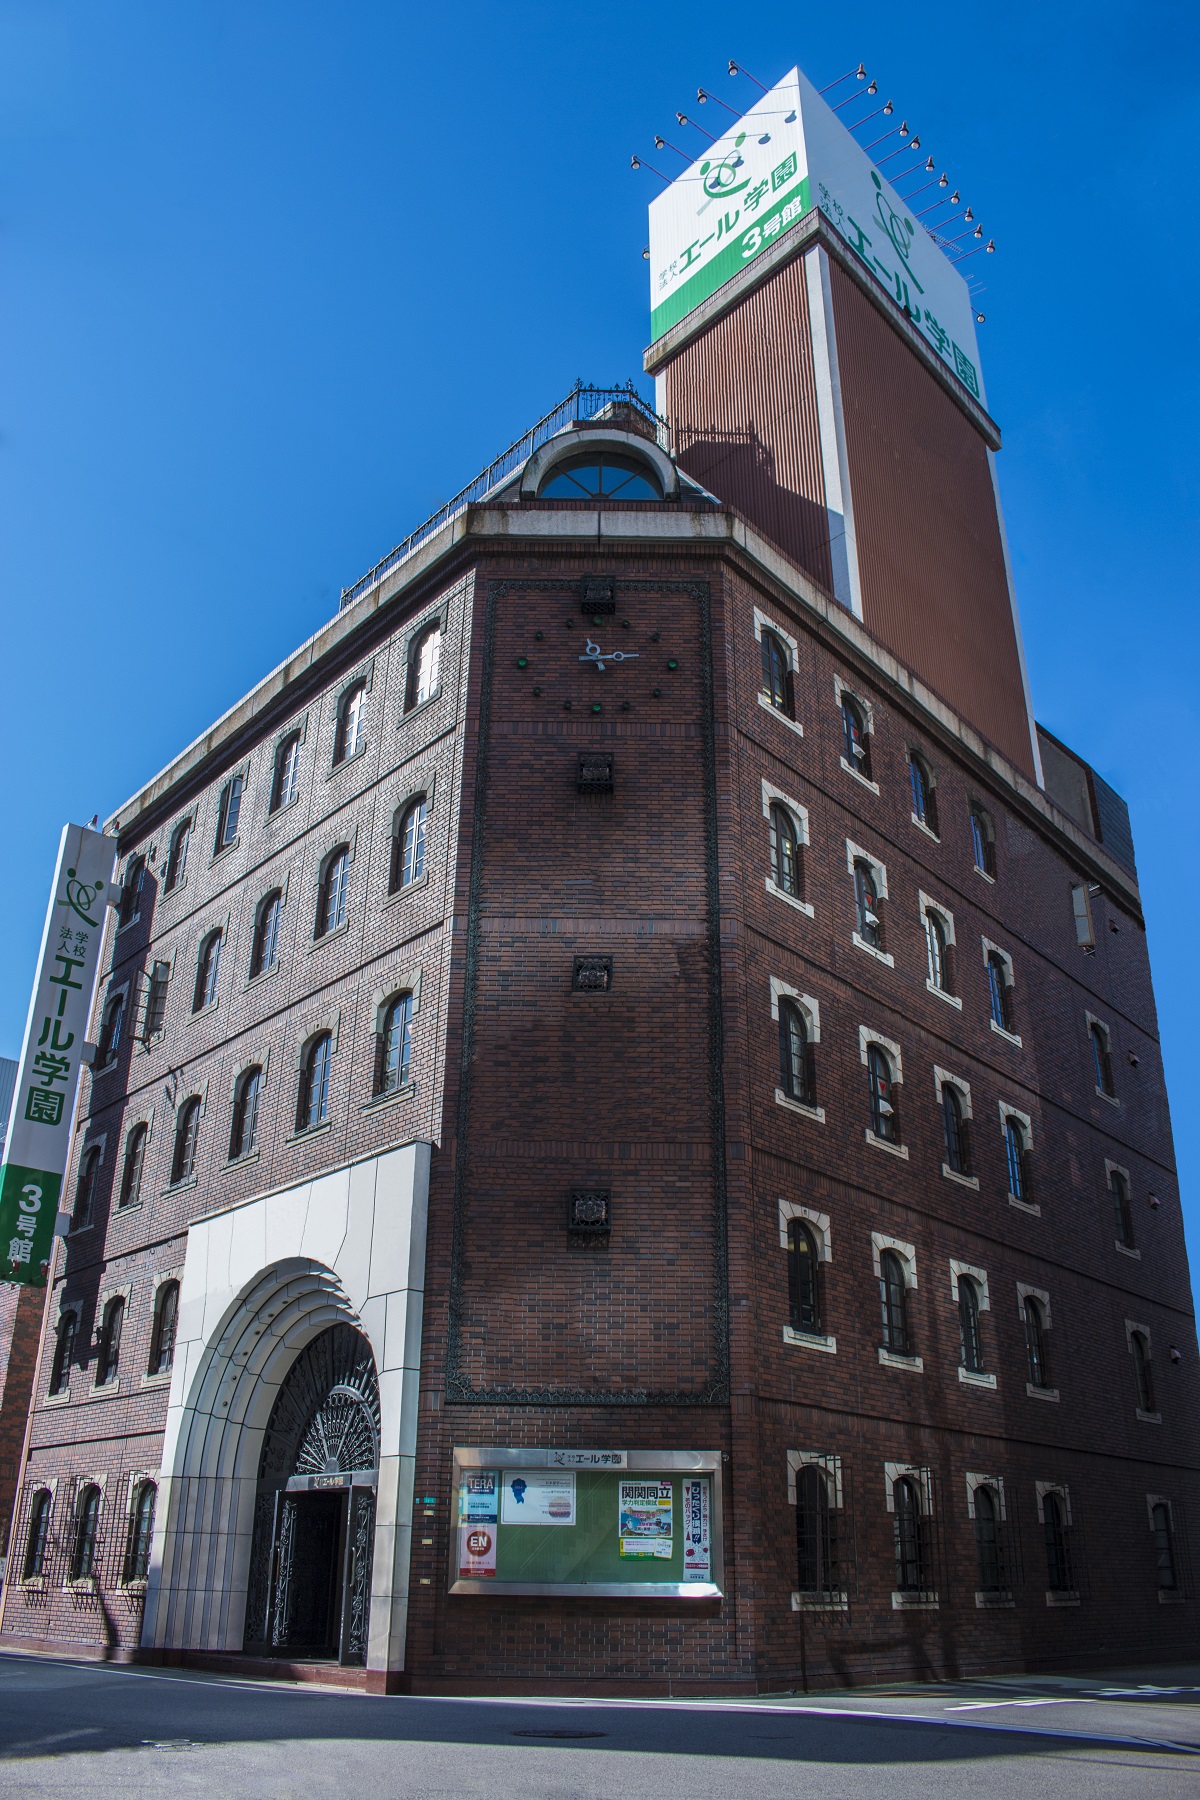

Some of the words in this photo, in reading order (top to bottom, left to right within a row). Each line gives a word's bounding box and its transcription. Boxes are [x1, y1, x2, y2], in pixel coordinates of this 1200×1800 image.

[679, 151, 798, 274] エール学園
[742, 195, 802, 258] 3号館
[847, 216, 980, 398] エール学園
[58, 926, 73, 954] 法人
[73, 931, 89, 958] 学校
[24, 954, 85, 1126] エール学園
[7, 1184, 43, 1263] 3号館
[576, 1454, 621, 1464] エール学園
[469, 1479, 493, 1489] TERA
[622, 1486, 671, 1499] 関関同立
[471, 1536, 488, 1547] EN
